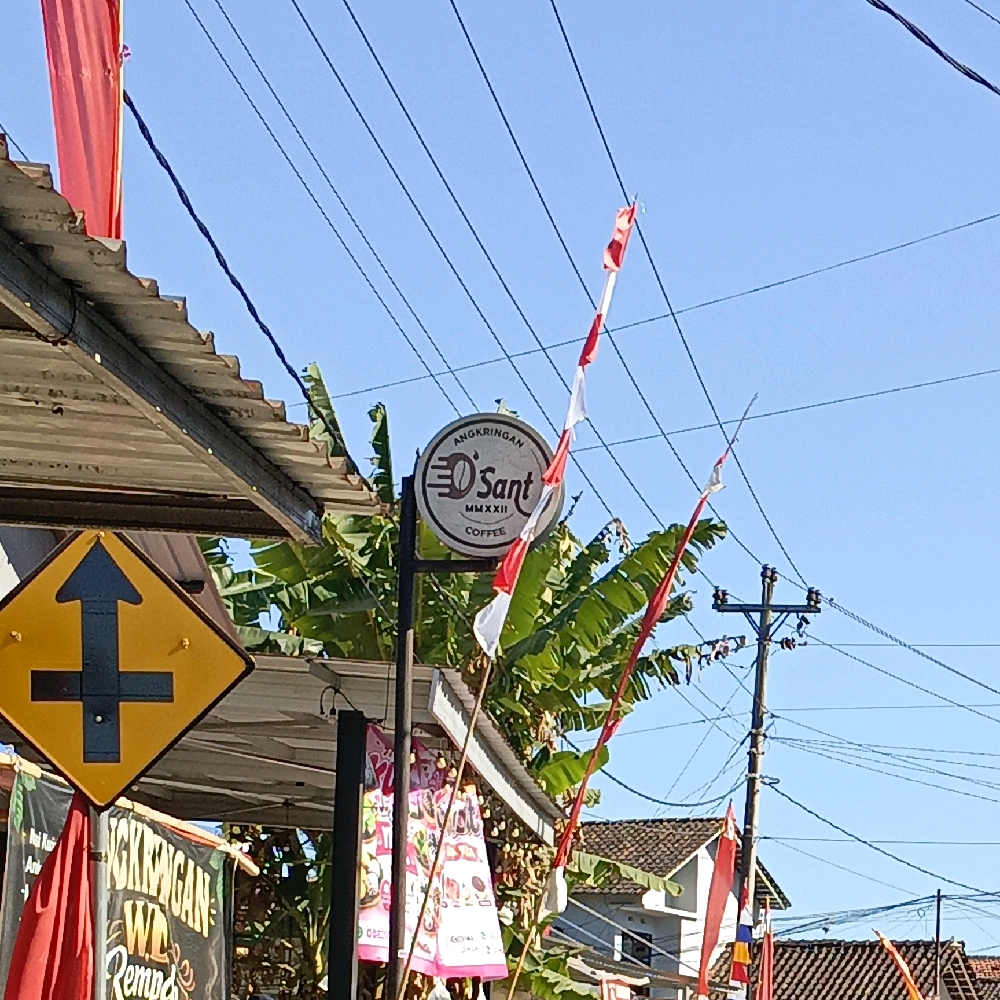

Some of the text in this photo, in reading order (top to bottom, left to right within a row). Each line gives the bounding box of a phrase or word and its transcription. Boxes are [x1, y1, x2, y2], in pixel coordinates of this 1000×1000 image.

[453, 427, 525, 448] ANGKRINGAN
[465, 504, 508, 513] MMXXII
[465, 526, 507, 537] COFFEE
